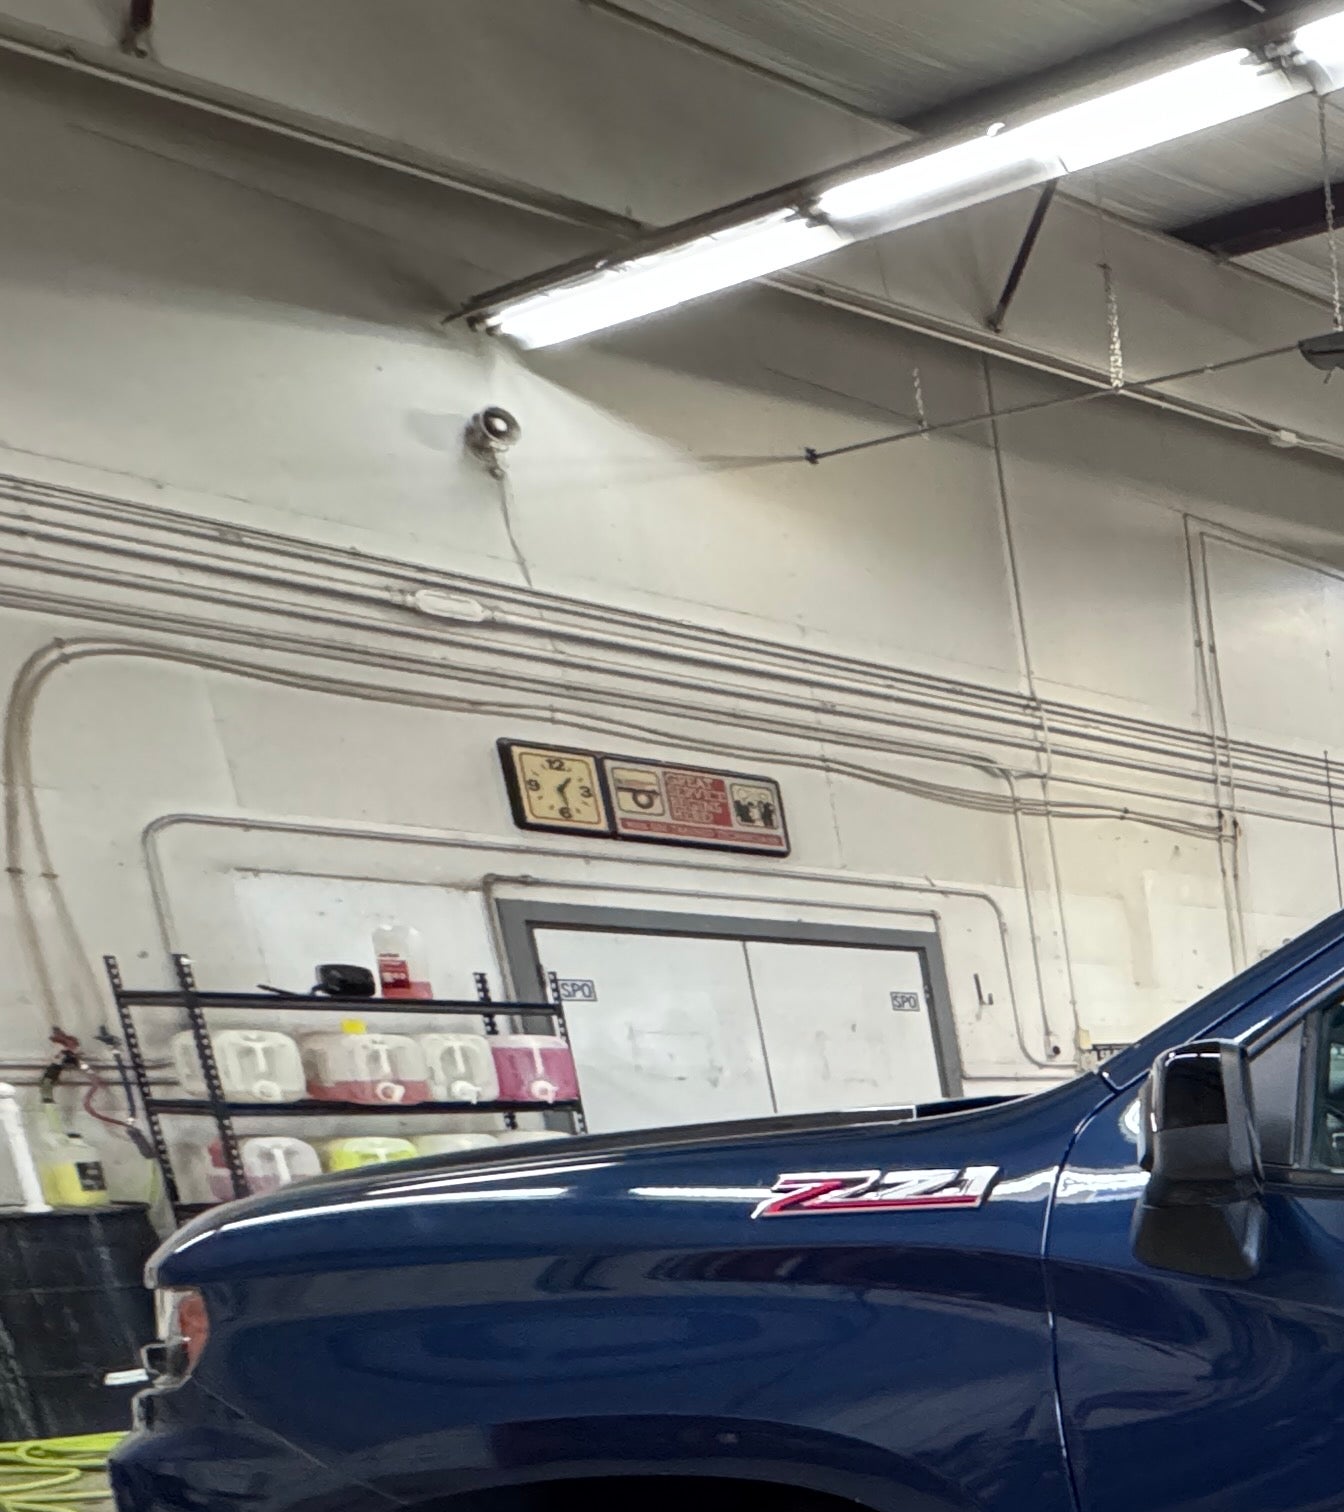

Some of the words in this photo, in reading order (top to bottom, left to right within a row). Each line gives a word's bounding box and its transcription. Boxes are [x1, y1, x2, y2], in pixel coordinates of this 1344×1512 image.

[546, 758, 565, 771] 12
[526, 778, 540, 792] 9
[579, 785, 593, 798] 3
[559, 805, 573, 819] 6
[750, 1166, 1000, 1219] Z71
